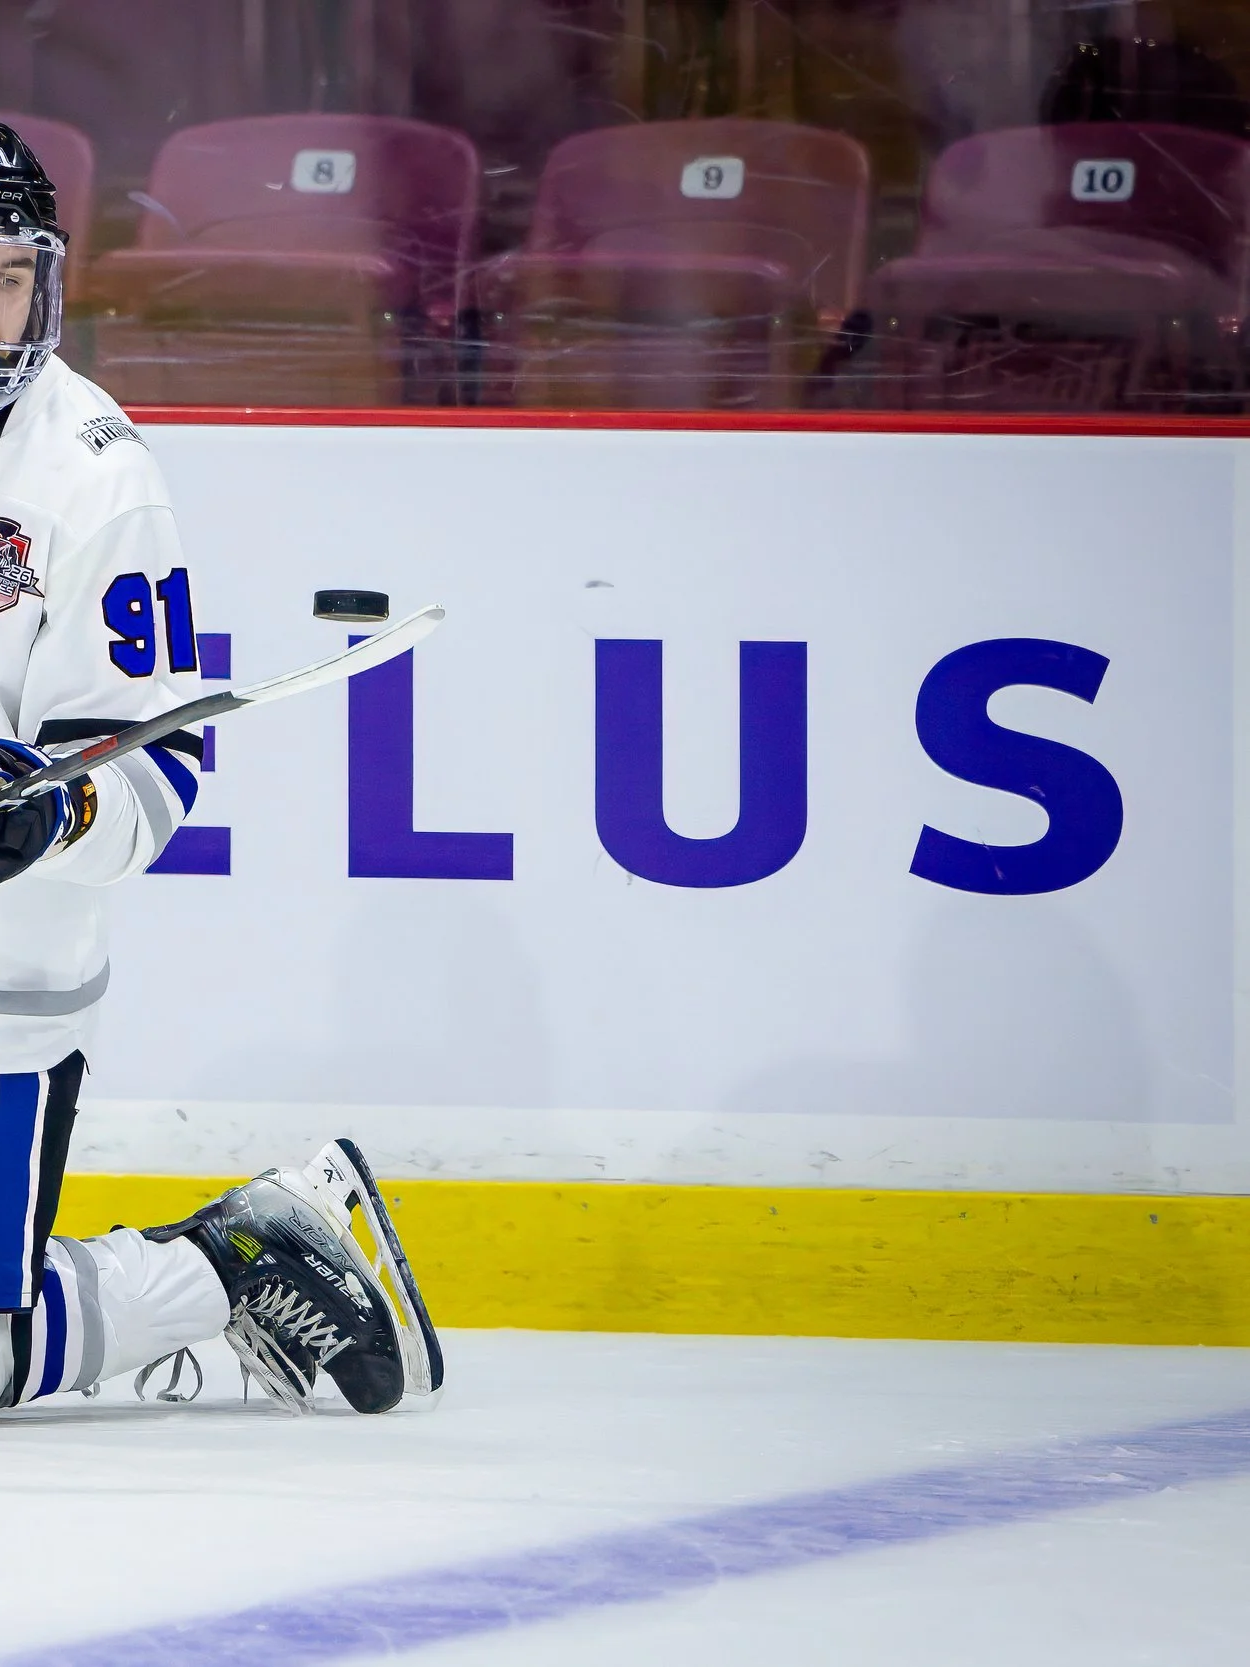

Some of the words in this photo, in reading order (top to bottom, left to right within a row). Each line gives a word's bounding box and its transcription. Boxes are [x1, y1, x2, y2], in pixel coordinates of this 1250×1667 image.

[312, 158, 334, 185] 8
[703, 165, 724, 190] 9
[1082, 166, 1125, 194] 10
[9, 569, 31, 583] 26
[101, 567, 198, 678] 91
